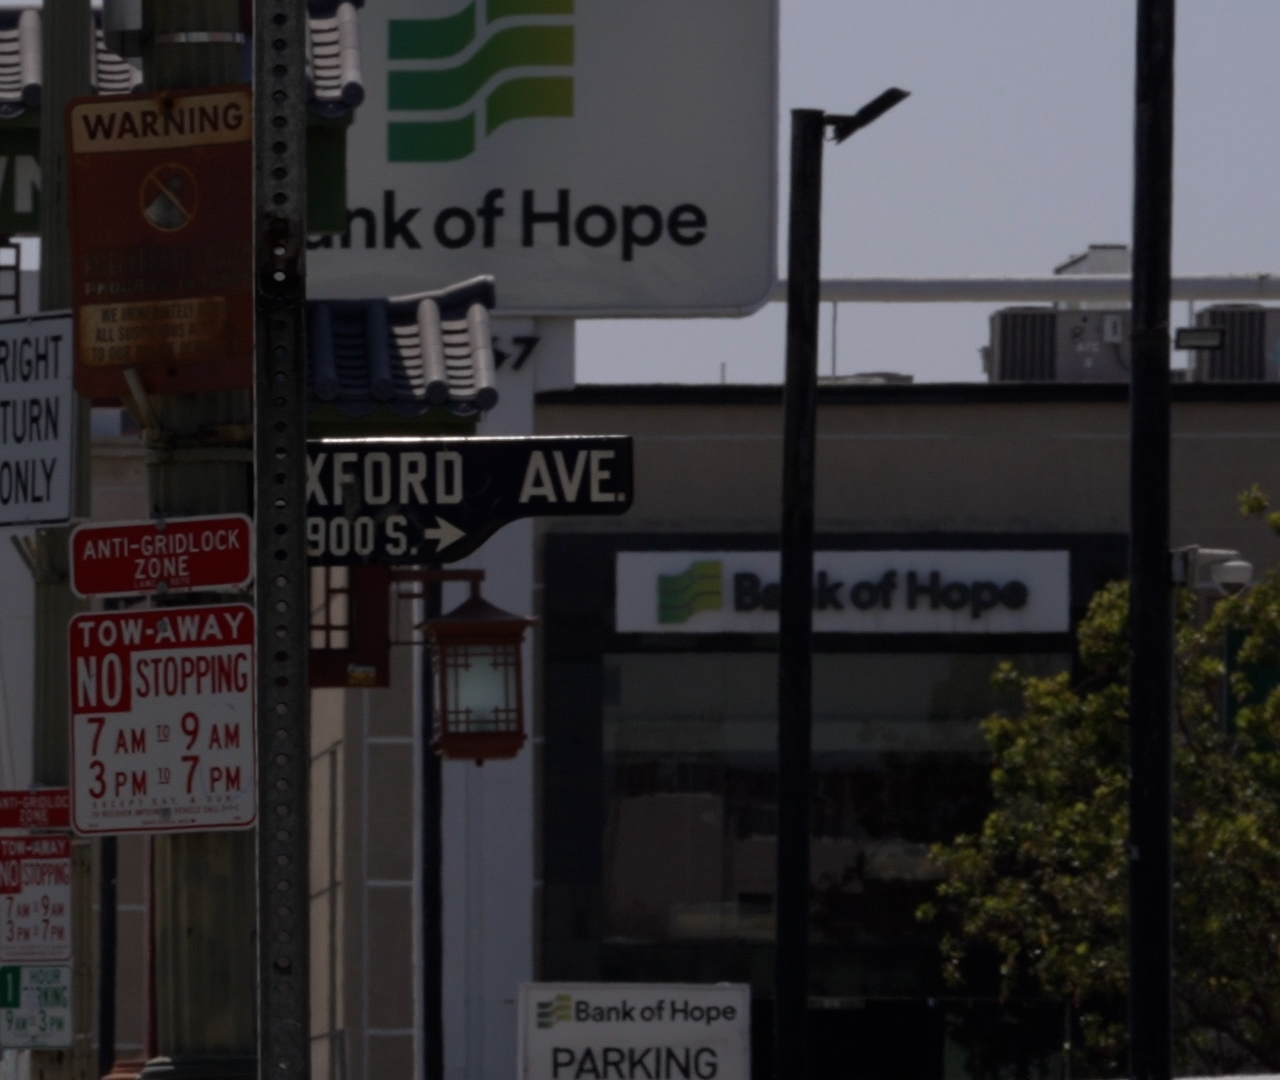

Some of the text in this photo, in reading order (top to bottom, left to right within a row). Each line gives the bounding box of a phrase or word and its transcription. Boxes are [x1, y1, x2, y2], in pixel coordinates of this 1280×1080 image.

[82, 102, 243, 140] WARNING
[434, 189, 503, 249] of
[522, 188, 706, 261] Hope
[101, 307, 117, 322] WE
[95, 327, 114, 342] ALL
[0, 396, 59, 444] TURN
[0, 457, 57, 505] ONLY
[518, 450, 626, 505] AVE.
[82, 529, 240, 561] ANTI-GRIDLOCK
[385, 514, 417, 556] S.
[133, 555, 189, 580] ZONE
[733, 568, 1028, 618] Bak of Hope
[78, 612, 244, 648] TOW-AWAY
[76, 652, 247, 708] NO STOPPING
[87, 712, 240, 757] 7 AM TO 9 AM
[88, 755, 241, 800] 3 PM TO 7 PM
[19, 809, 48, 821] ZONE
[1, 840, 67, 856] TOW-AWAY
[23, 862, 70, 885] STOPPING
[6, 896, 14, 918] 7
[41, 895, 49, 916] 9
[6, 918, 64, 943] 3 PM 7 PM
[6, 969, 61, 1002] 1 HOUR
[6, 1009, 14, 1031] 9
[39, 1009, 47, 1031] 3
[574, 1000, 736, 1025] Bank of Hope
[552, 1047, 717, 1080] PARKING
